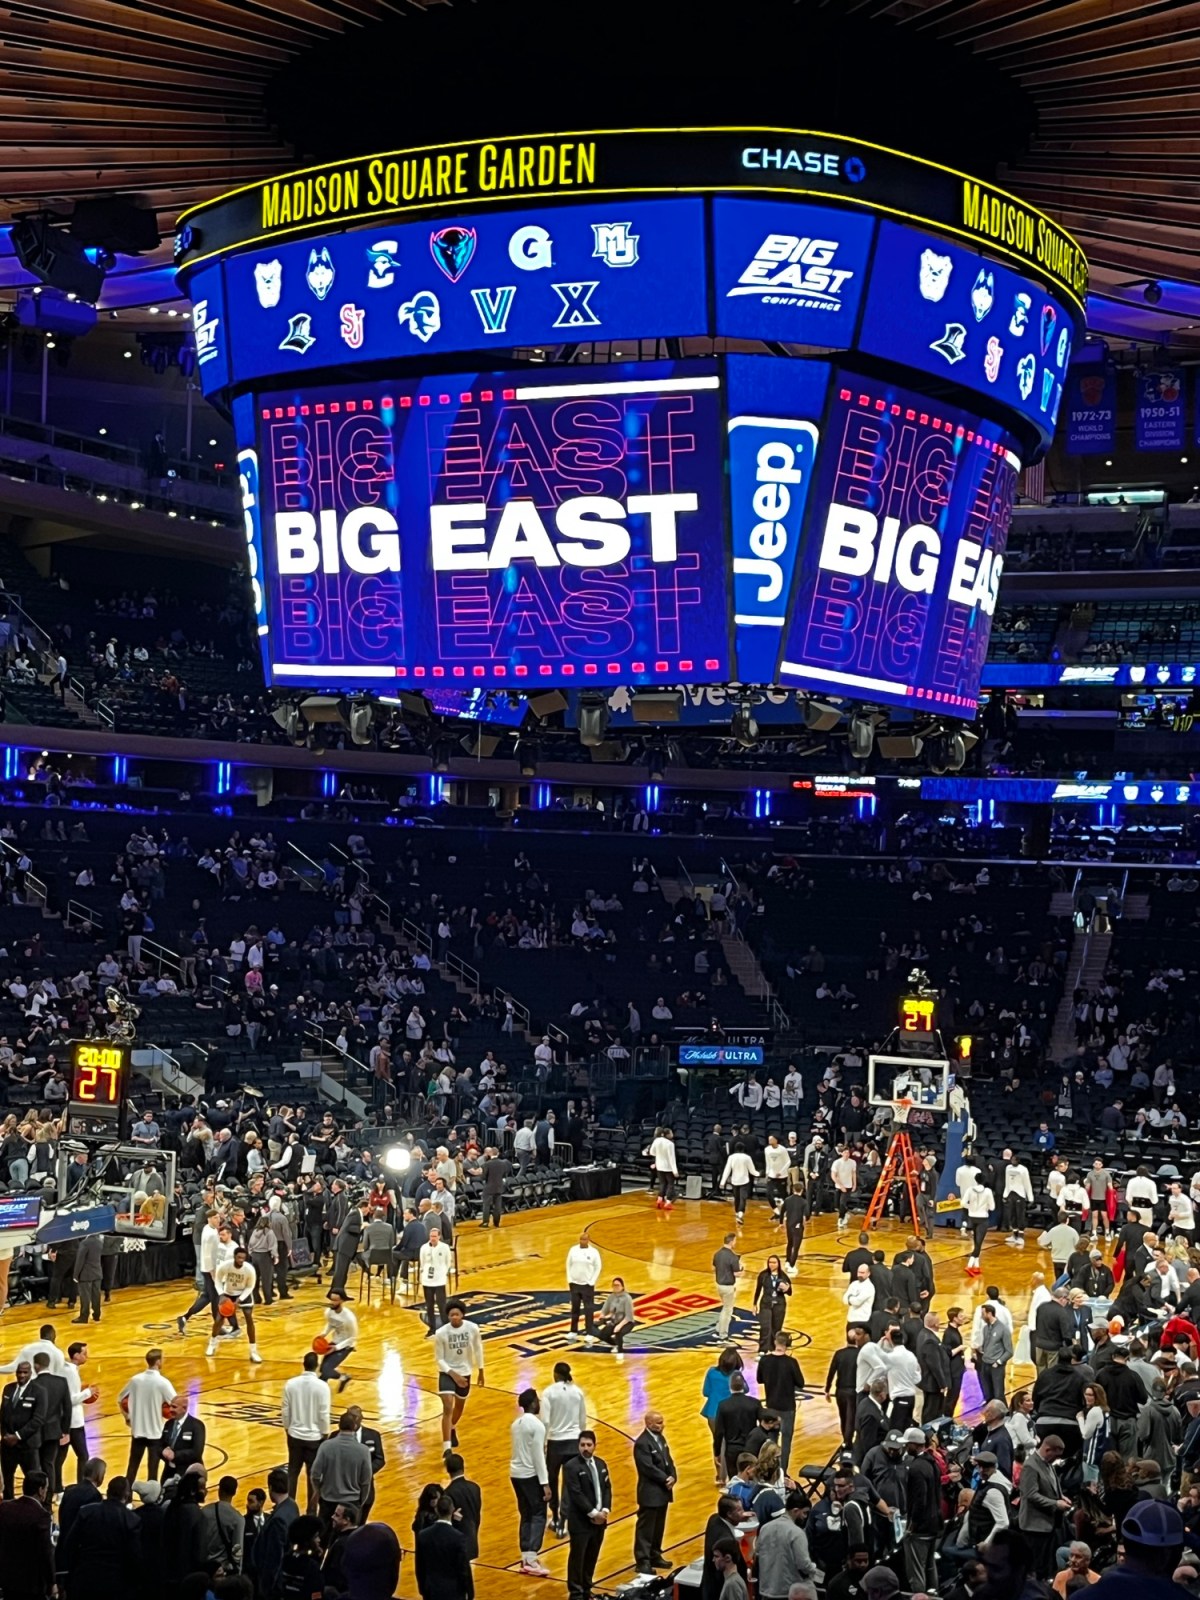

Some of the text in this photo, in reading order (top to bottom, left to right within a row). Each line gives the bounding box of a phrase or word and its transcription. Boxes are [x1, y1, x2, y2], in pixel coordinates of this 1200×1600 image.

[741, 147, 840, 177] CHASE
[754, 235, 839, 267] BIG
[738, 260, 854, 293] EAST
[550, 281, 602, 328] X
[761, 296, 842, 312] CONFERENCE
[1071, 410, 1112, 421] 1972-73
[1140, 406, 1180, 418] 1950-51
[1070, 433, 1112, 441] CHAMPIONS
[1078, 424, 1104, 432] WORLD
[275, 505, 400, 574] BIG
[429, 492, 698, 571] EAST
[733, 441, 803, 602] Jeep
[818, 502, 941, 594] BIG
[905, 1011, 932, 1031] 27
[78, 1046, 121, 1069] 20:00
[724, 1050, 758, 1061] ULTRA
[79, 1066, 116, 1101] 27
